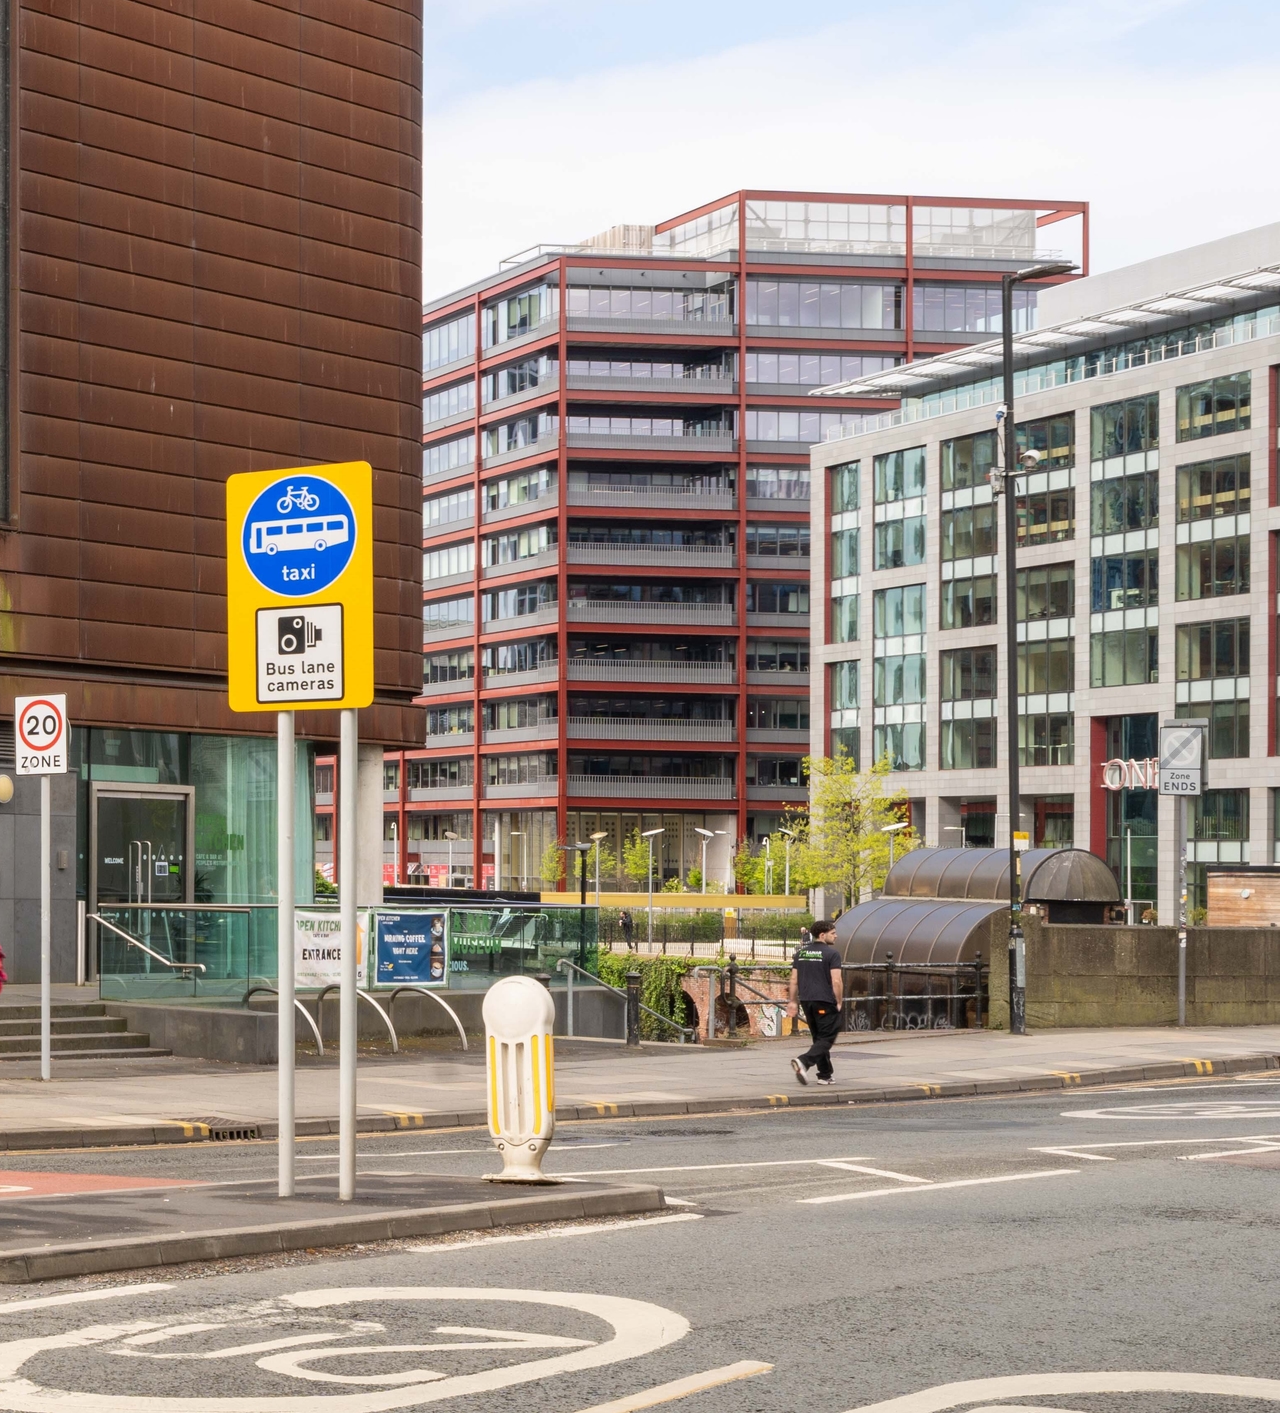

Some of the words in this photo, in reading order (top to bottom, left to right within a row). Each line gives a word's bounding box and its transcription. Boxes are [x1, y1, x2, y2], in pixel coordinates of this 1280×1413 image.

[282, 563, 316, 581] taxi
[266, 662, 295, 676] Bus
[302, 661, 335, 674] lane
[267, 679, 334, 692] cameras
[27, 715, 56, 736] 20
[21, 755, 61, 768] ZONE
[1170, 772, 1190, 780] Zone
[1164, 782, 1196, 791] ENDS
[405, 935, 426, 943] COFFEE
[450, 937, 502, 955] MUSEUM
[302, 948, 341, 960] ENTRANCE
